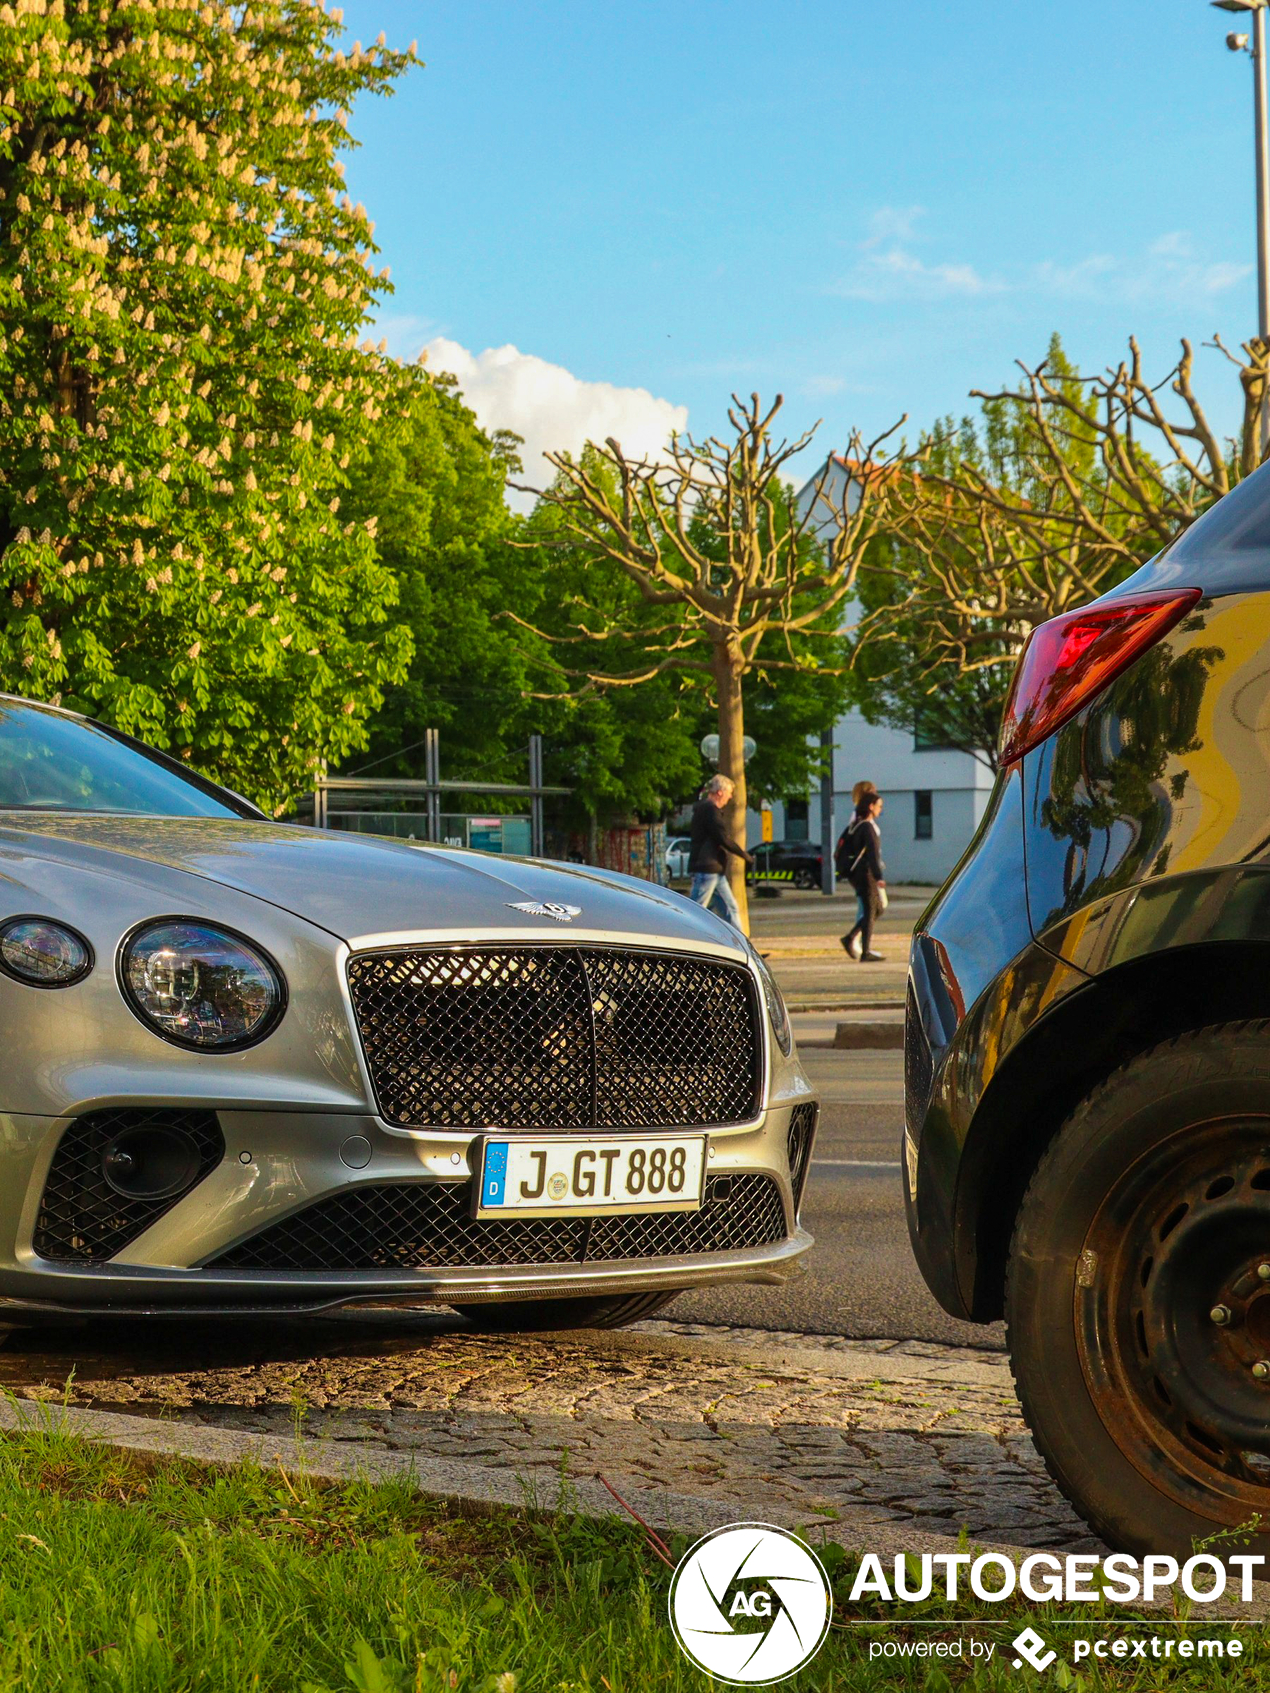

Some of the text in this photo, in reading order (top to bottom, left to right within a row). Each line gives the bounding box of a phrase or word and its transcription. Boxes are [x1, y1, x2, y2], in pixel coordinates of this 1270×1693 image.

[489, 1182, 499, 1196] D
[520, 1147, 687, 1199] J GT 888
